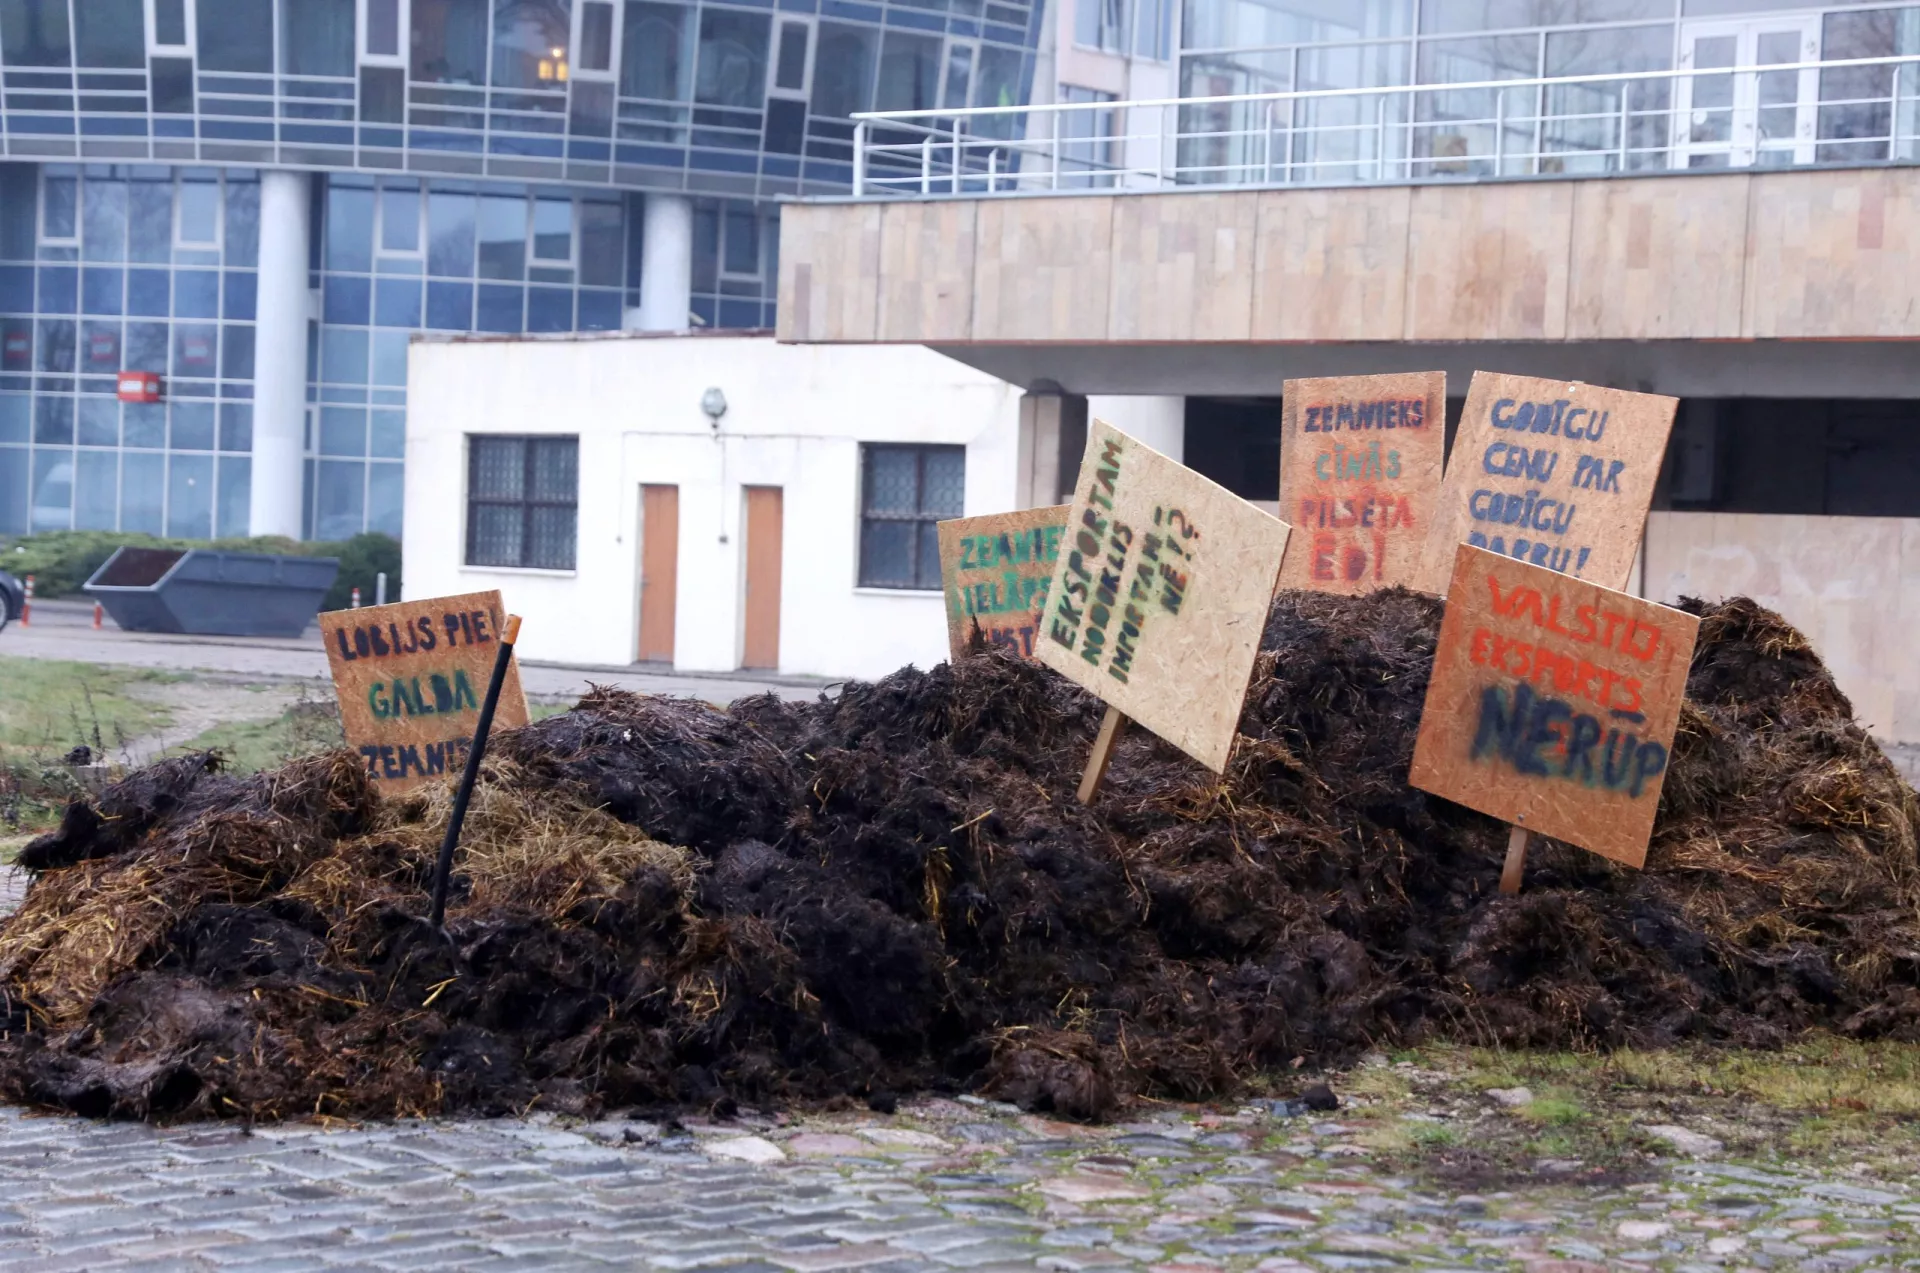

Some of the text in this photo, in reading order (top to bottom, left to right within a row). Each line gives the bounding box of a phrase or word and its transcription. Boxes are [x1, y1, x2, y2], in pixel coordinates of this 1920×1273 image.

[1304, 399, 1424, 432] ZEMNIEKS
[1483, 441, 1625, 494] CENU PAR
[1469, 489, 1576, 534] GODĪGU
[960, 525, 1066, 570] ZEMNIE
[1050, 438, 1123, 650] EKSPORTAM
[1081, 519, 1133, 667] NODOKLIS
[1108, 532, 1162, 685] IMPORTAM
[336, 616, 437, 661] LOBIJS
[368, 668, 477, 720] GALDA
[1470, 628, 1643, 712] EKSPORTS
[1468, 680, 1667, 799] NERŪP
